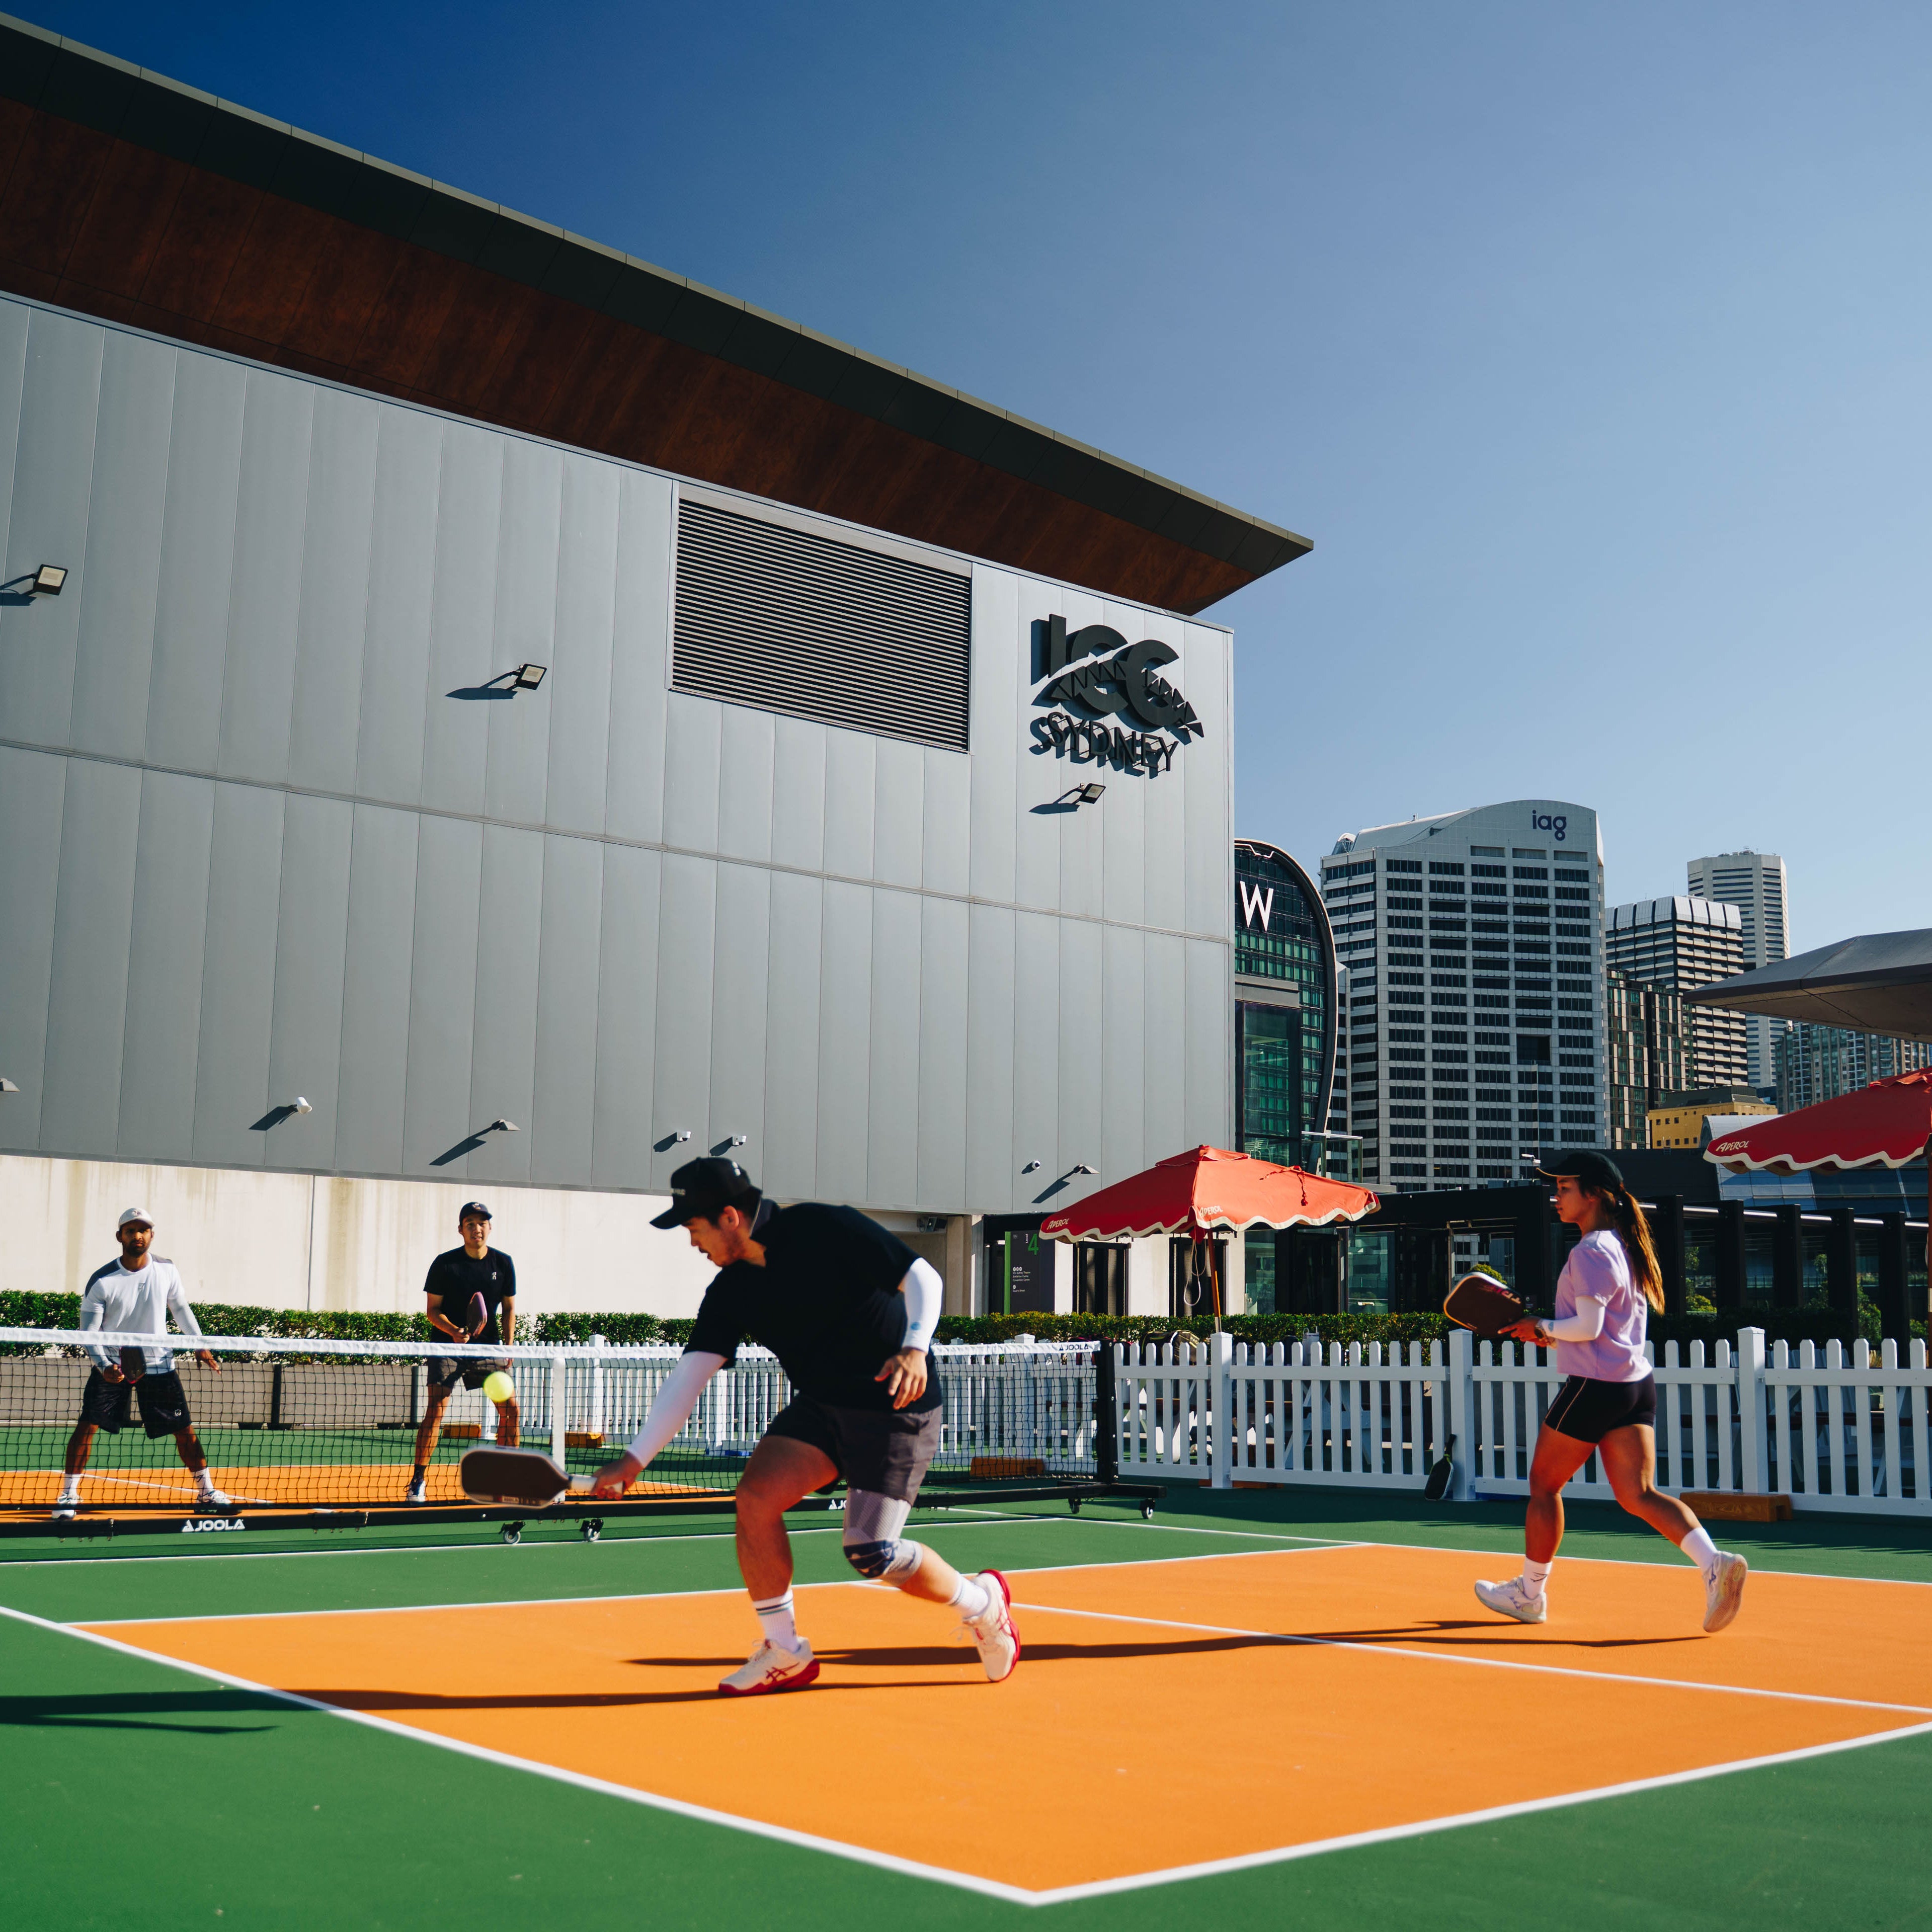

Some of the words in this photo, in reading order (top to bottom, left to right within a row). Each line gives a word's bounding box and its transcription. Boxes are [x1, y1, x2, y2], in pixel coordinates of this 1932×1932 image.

[1049, 613, 1180, 727] ICC
[1047, 711, 1179, 772] SYDNEY
[1532, 810, 1567, 841] iag
[1240, 880, 1274, 932] W
[1715, 1140, 1749, 1152] APEROL
[1199, 1205, 1223, 1217] APEROL
[1046, 1218, 1069, 1230] APEROL
[1028, 1233, 1039, 1255] 4
[194, 1518, 246, 1532] JOOLA
